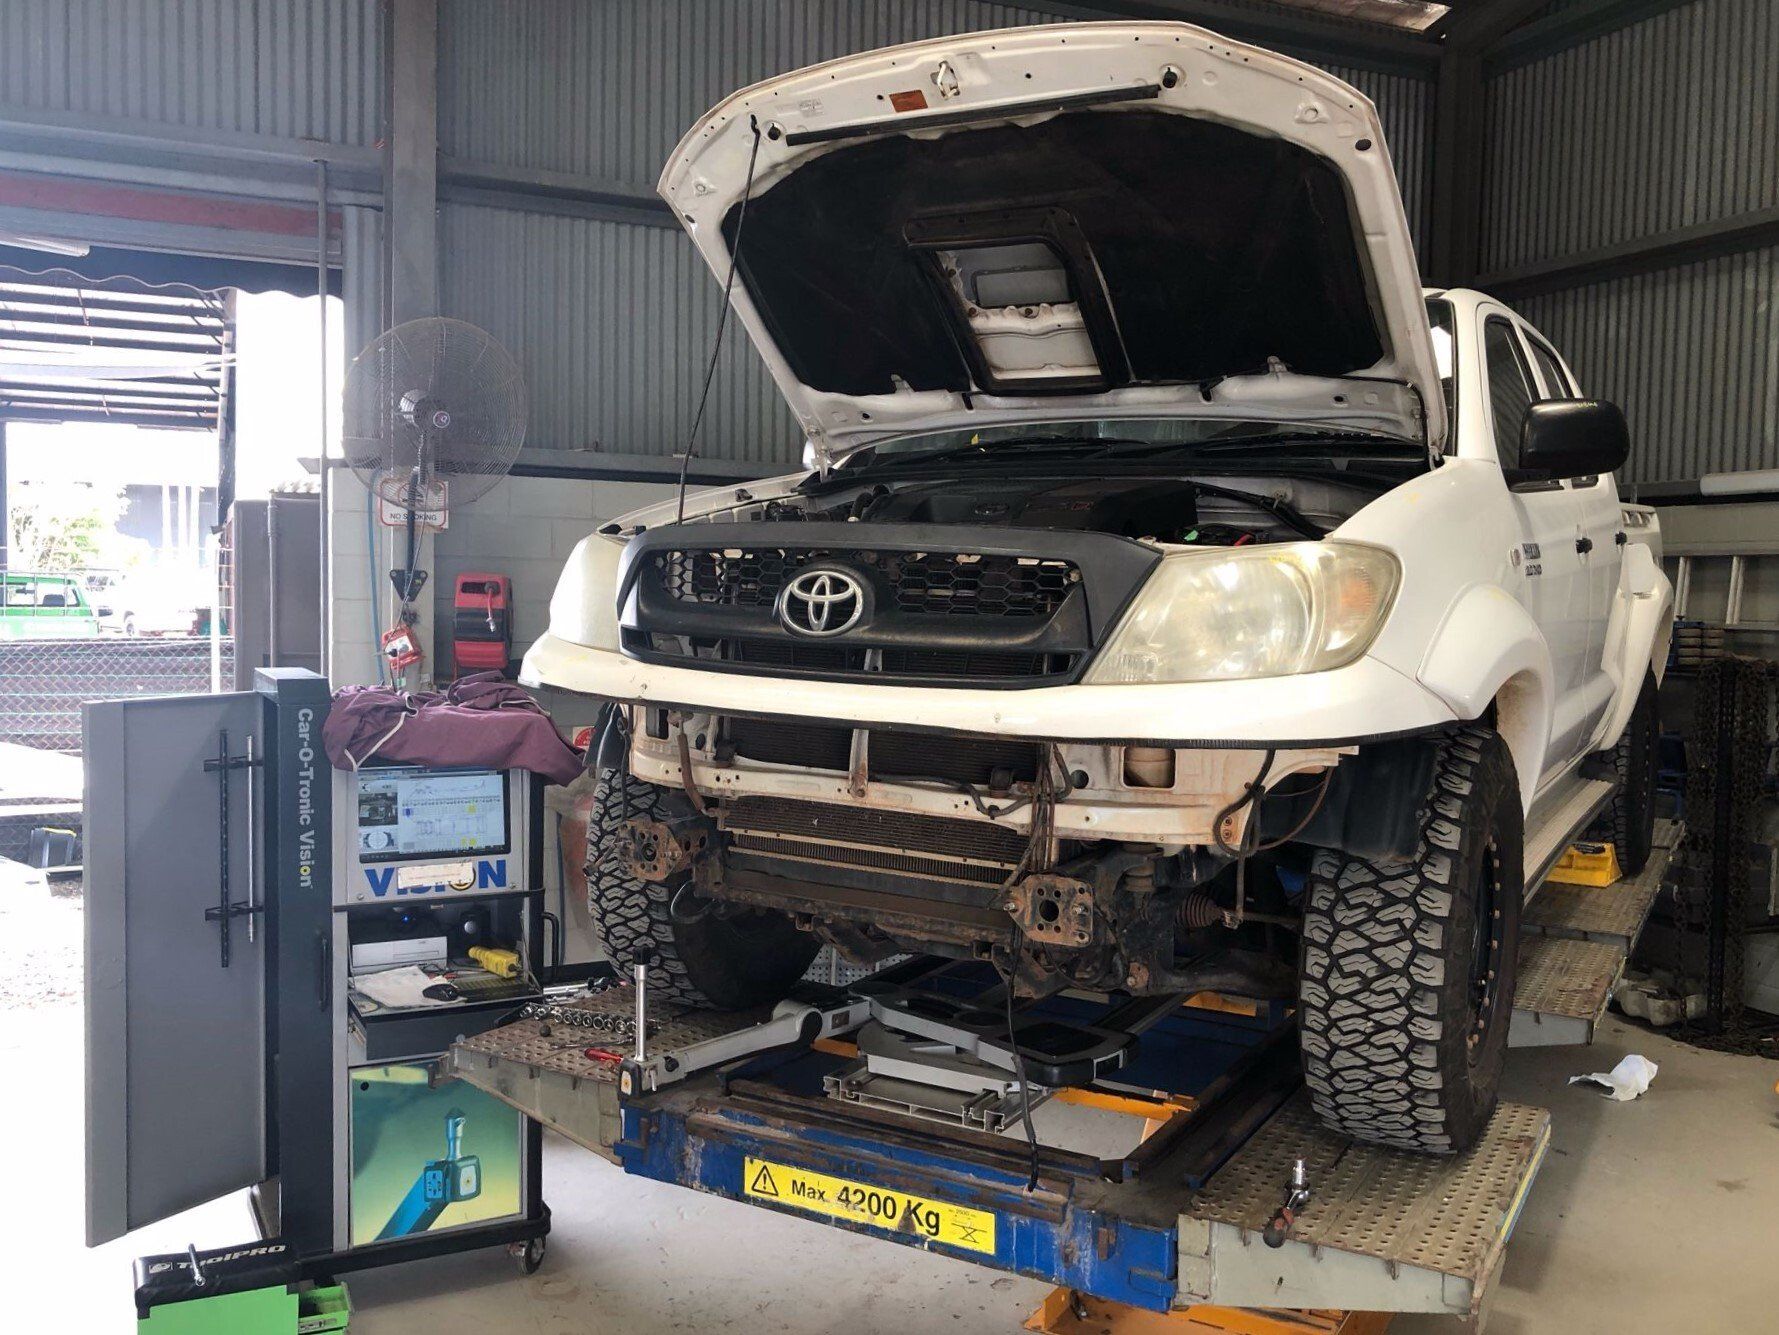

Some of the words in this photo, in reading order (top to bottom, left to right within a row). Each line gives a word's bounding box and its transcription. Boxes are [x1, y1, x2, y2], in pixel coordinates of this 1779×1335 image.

[403, 513, 437, 521] SOKING
[298, 708, 314, 826] Car-O-Tronic
[300, 829, 315, 888] Vision
[836, 1185, 897, 1220] 4200
[905, 1199, 940, 1237] Kg
